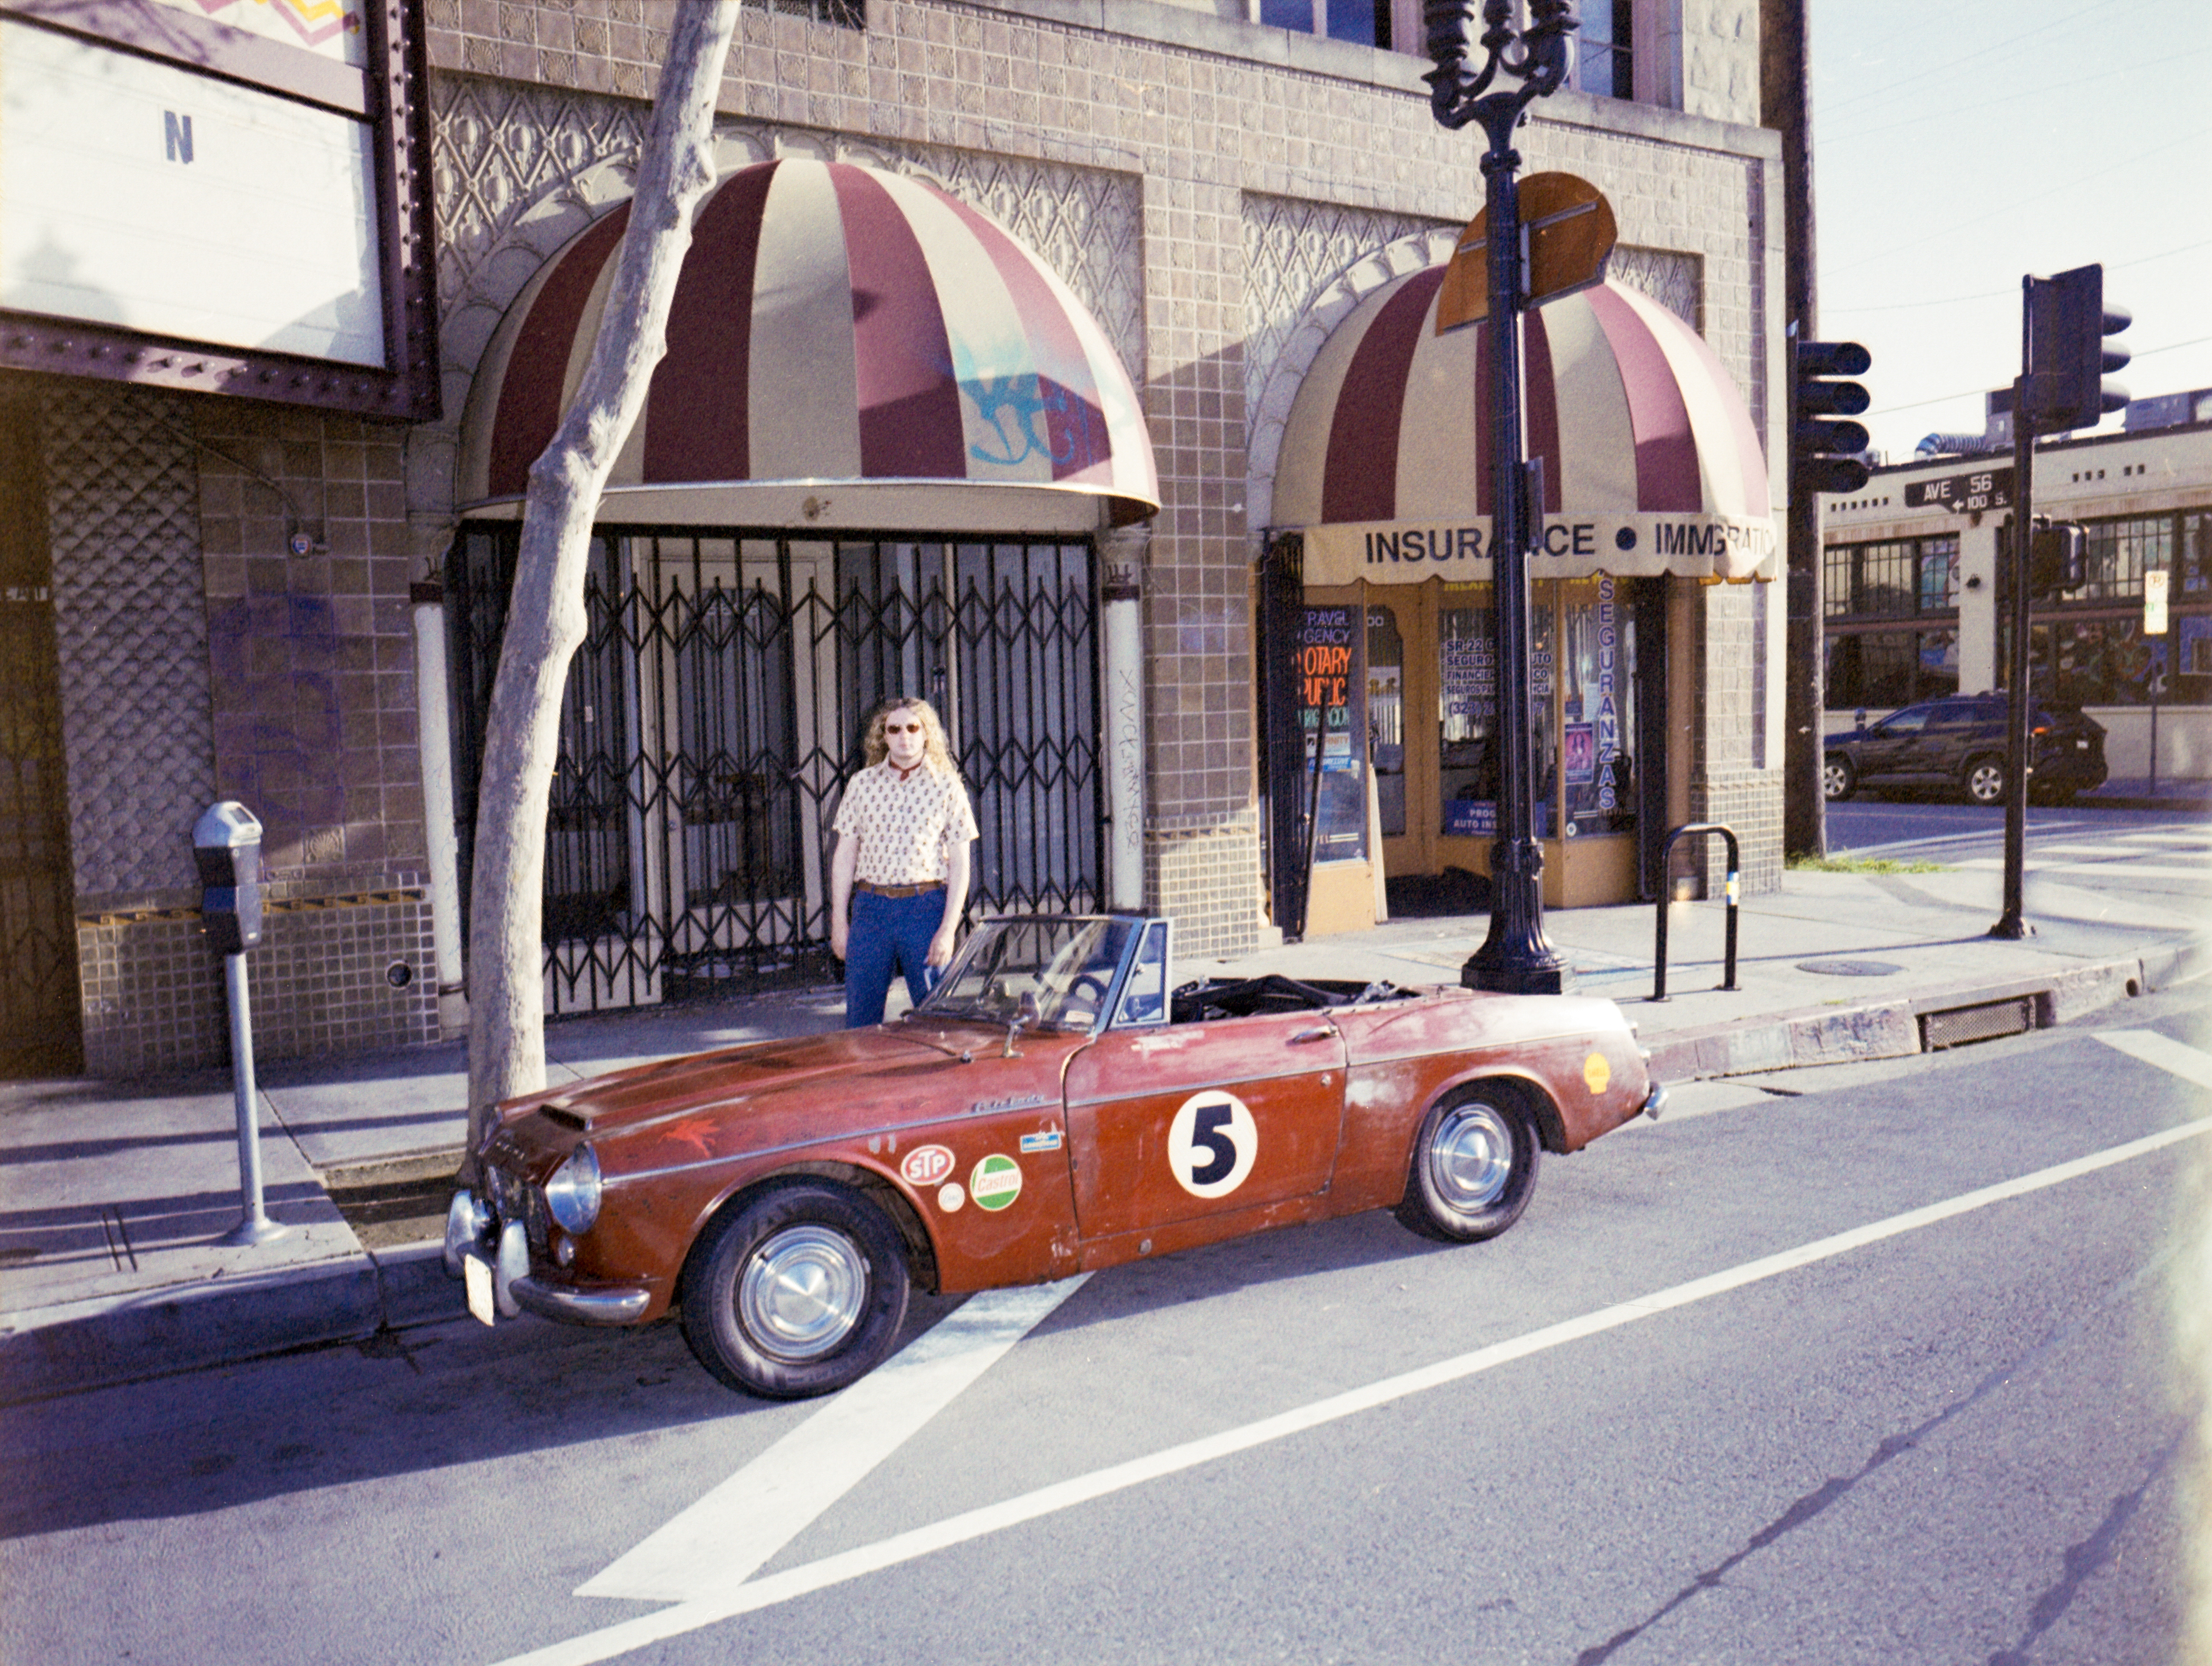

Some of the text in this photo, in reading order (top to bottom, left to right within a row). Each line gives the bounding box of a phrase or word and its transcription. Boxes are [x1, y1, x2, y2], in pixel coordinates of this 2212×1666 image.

[163, 110, 194, 165] N
[1924, 473, 1992, 502] AVE 56
[1967, 494, 1987, 509] 100
[1365, 524, 1595, 563] INSURCE
[1297, 628, 1350, 644] GENCY
[1297, 646, 1352, 675] OTARY
[1447, 654, 1494, 666] SEGURO
[1454, 819, 1479, 828] AUTO
[1191, 1103, 1237, 1186] 5
[909, 1150, 946, 1179] STP
[977, 1169, 1020, 1192] Castrol
